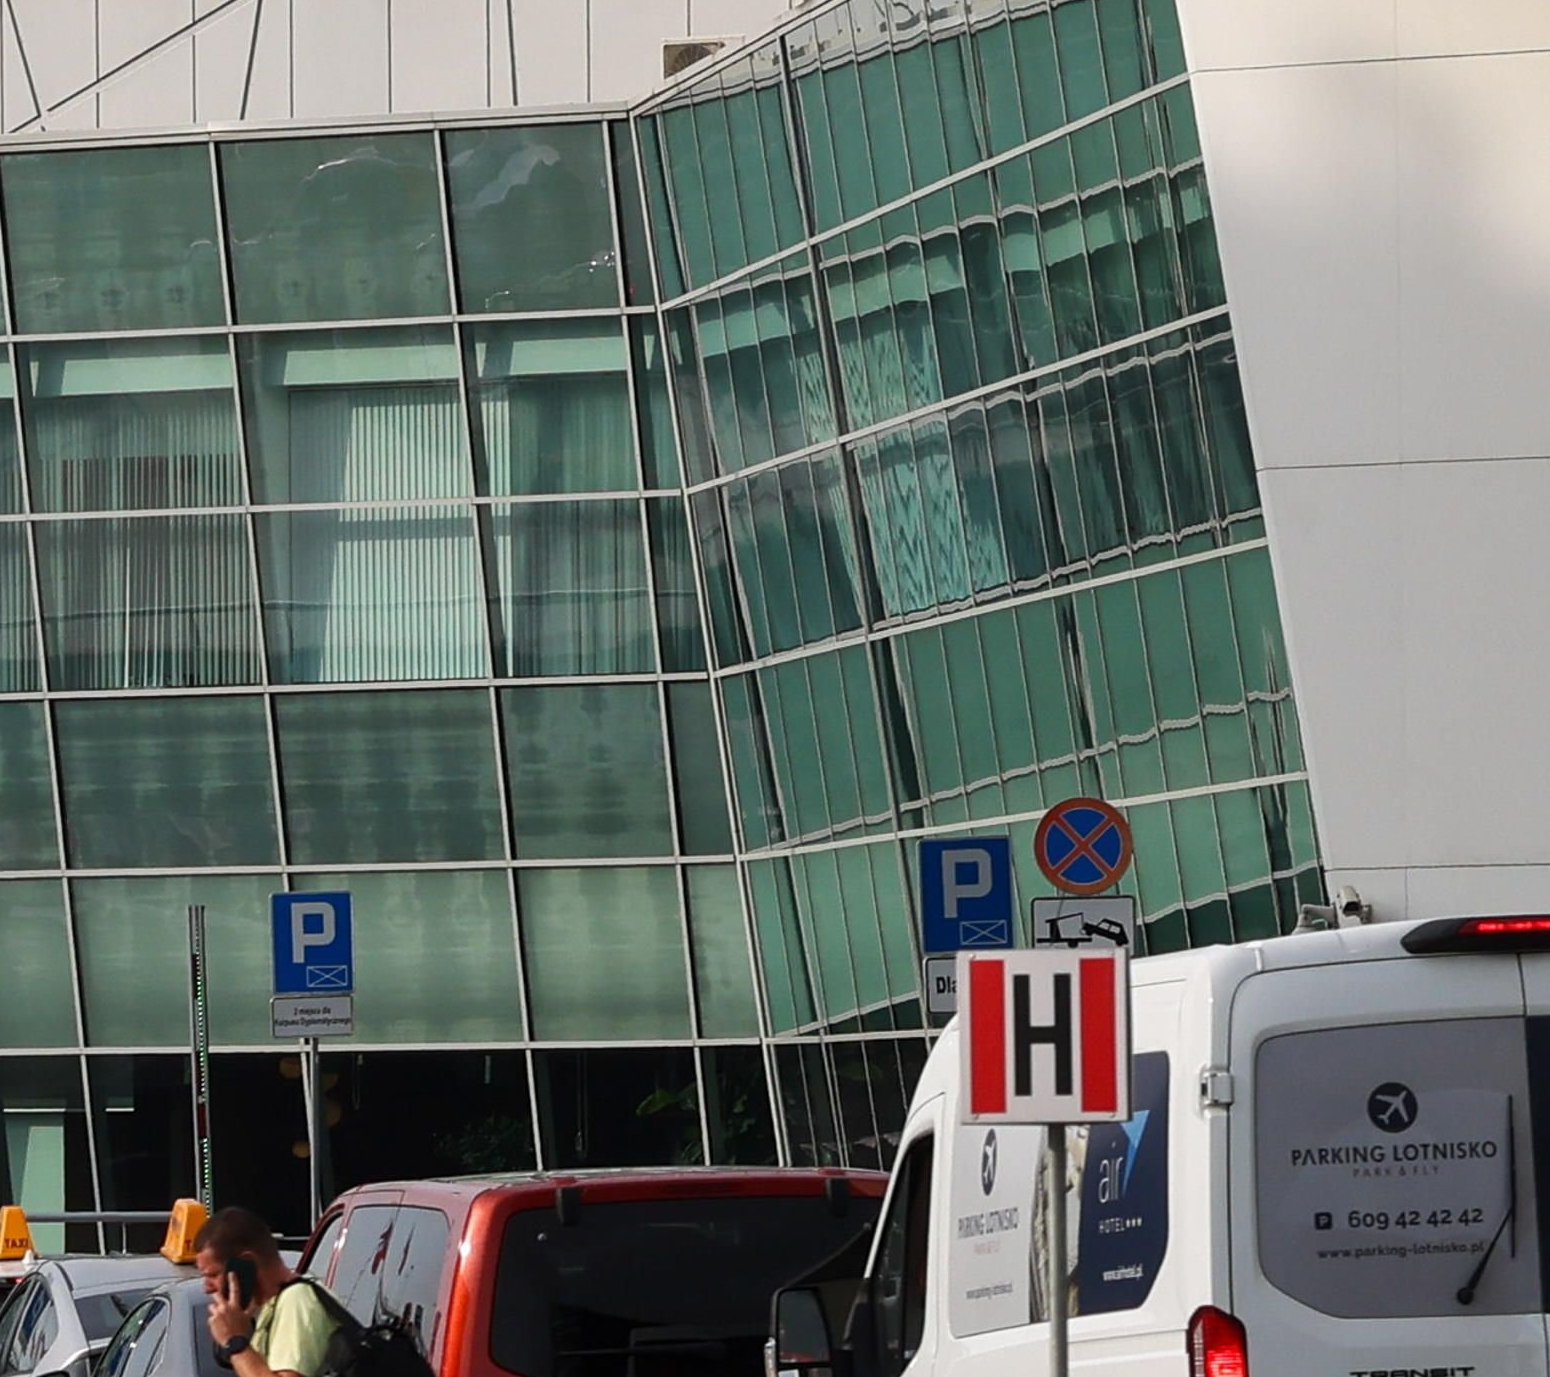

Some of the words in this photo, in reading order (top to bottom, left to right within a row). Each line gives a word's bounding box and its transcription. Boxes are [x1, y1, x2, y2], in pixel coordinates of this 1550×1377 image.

[941, 848, 992, 918] P
[291, 902, 336, 963] P
[1013, 973, 1073, 1097] H
[1099, 1141, 1123, 1203] air
[1291, 1146, 1385, 1166] PARKING
[1393, 1140, 1497, 1162] LOTNISKO
[1348, 1210, 1389, 1230] 609
[1395, 1210, 1421, 1229] 42
[1427, 1209, 1453, 1228] 42
[1458, 1208, 1484, 1226] 42
[4, 1238, 28, 1248] TAXI
[1318, 1240, 1485, 1259] www.parking-lotnisko.pl
